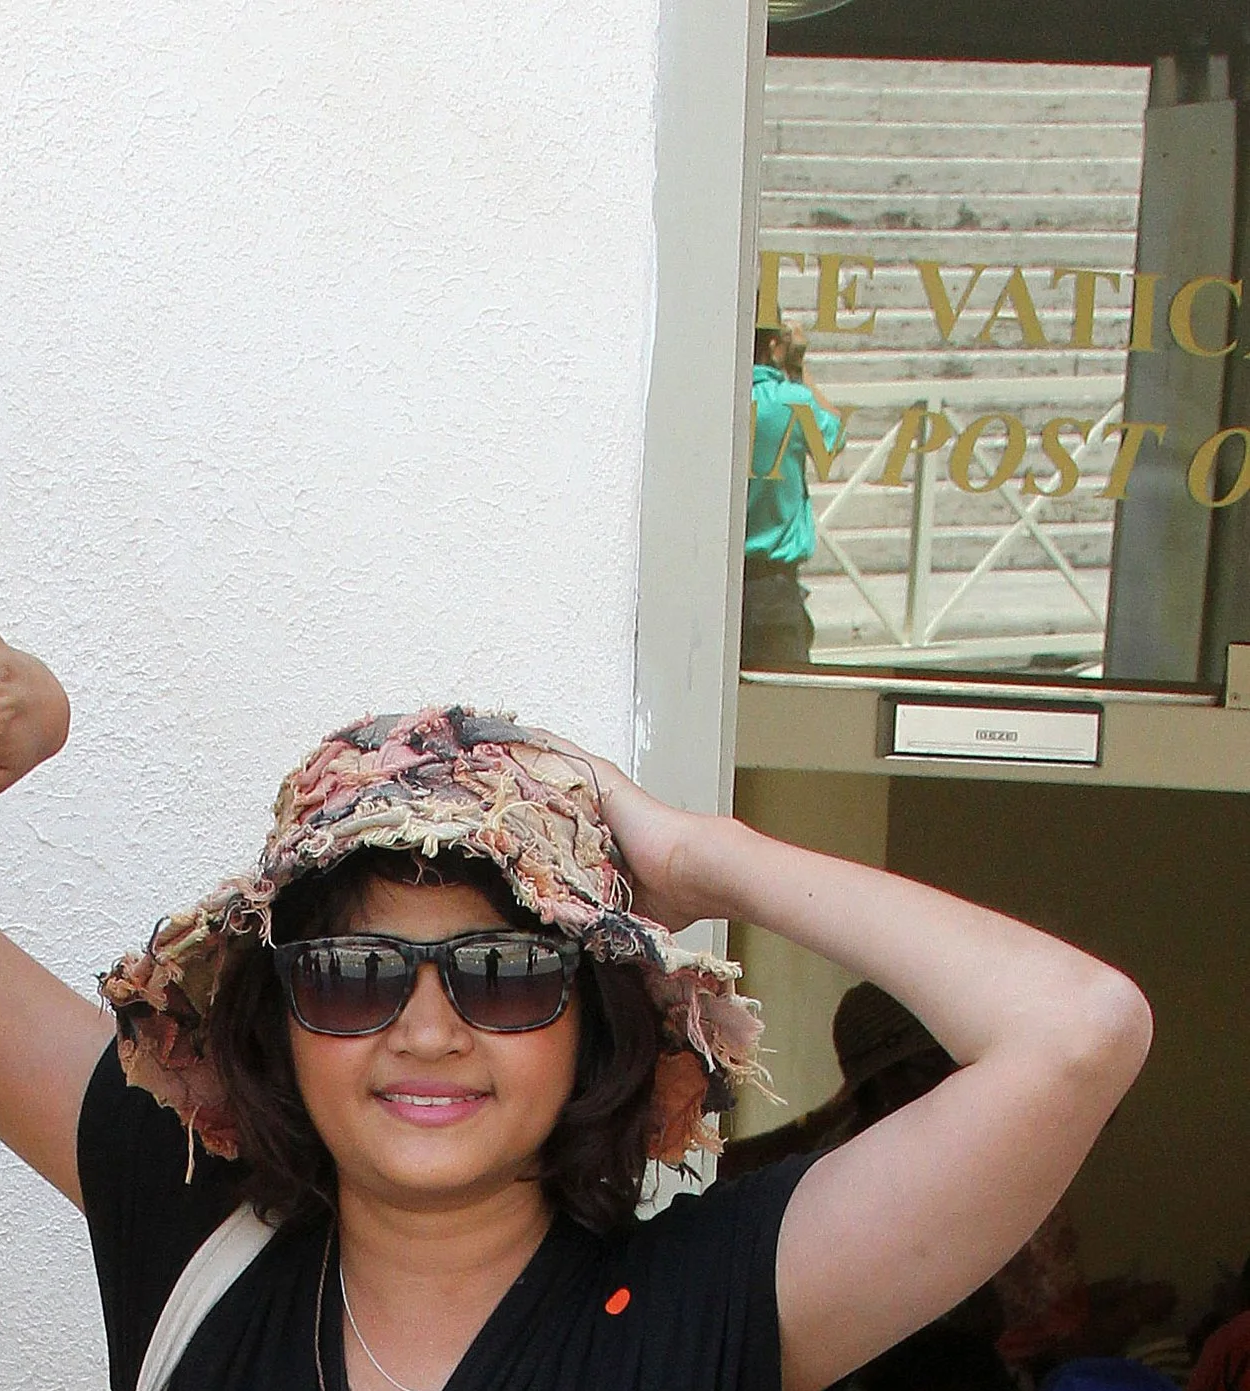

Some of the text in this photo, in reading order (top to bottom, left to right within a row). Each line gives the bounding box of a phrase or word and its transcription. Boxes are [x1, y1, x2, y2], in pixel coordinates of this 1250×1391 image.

[916, 259, 1250, 359] VATIC
[748, 400, 858, 480] N
[867, 404, 1168, 500] POST
